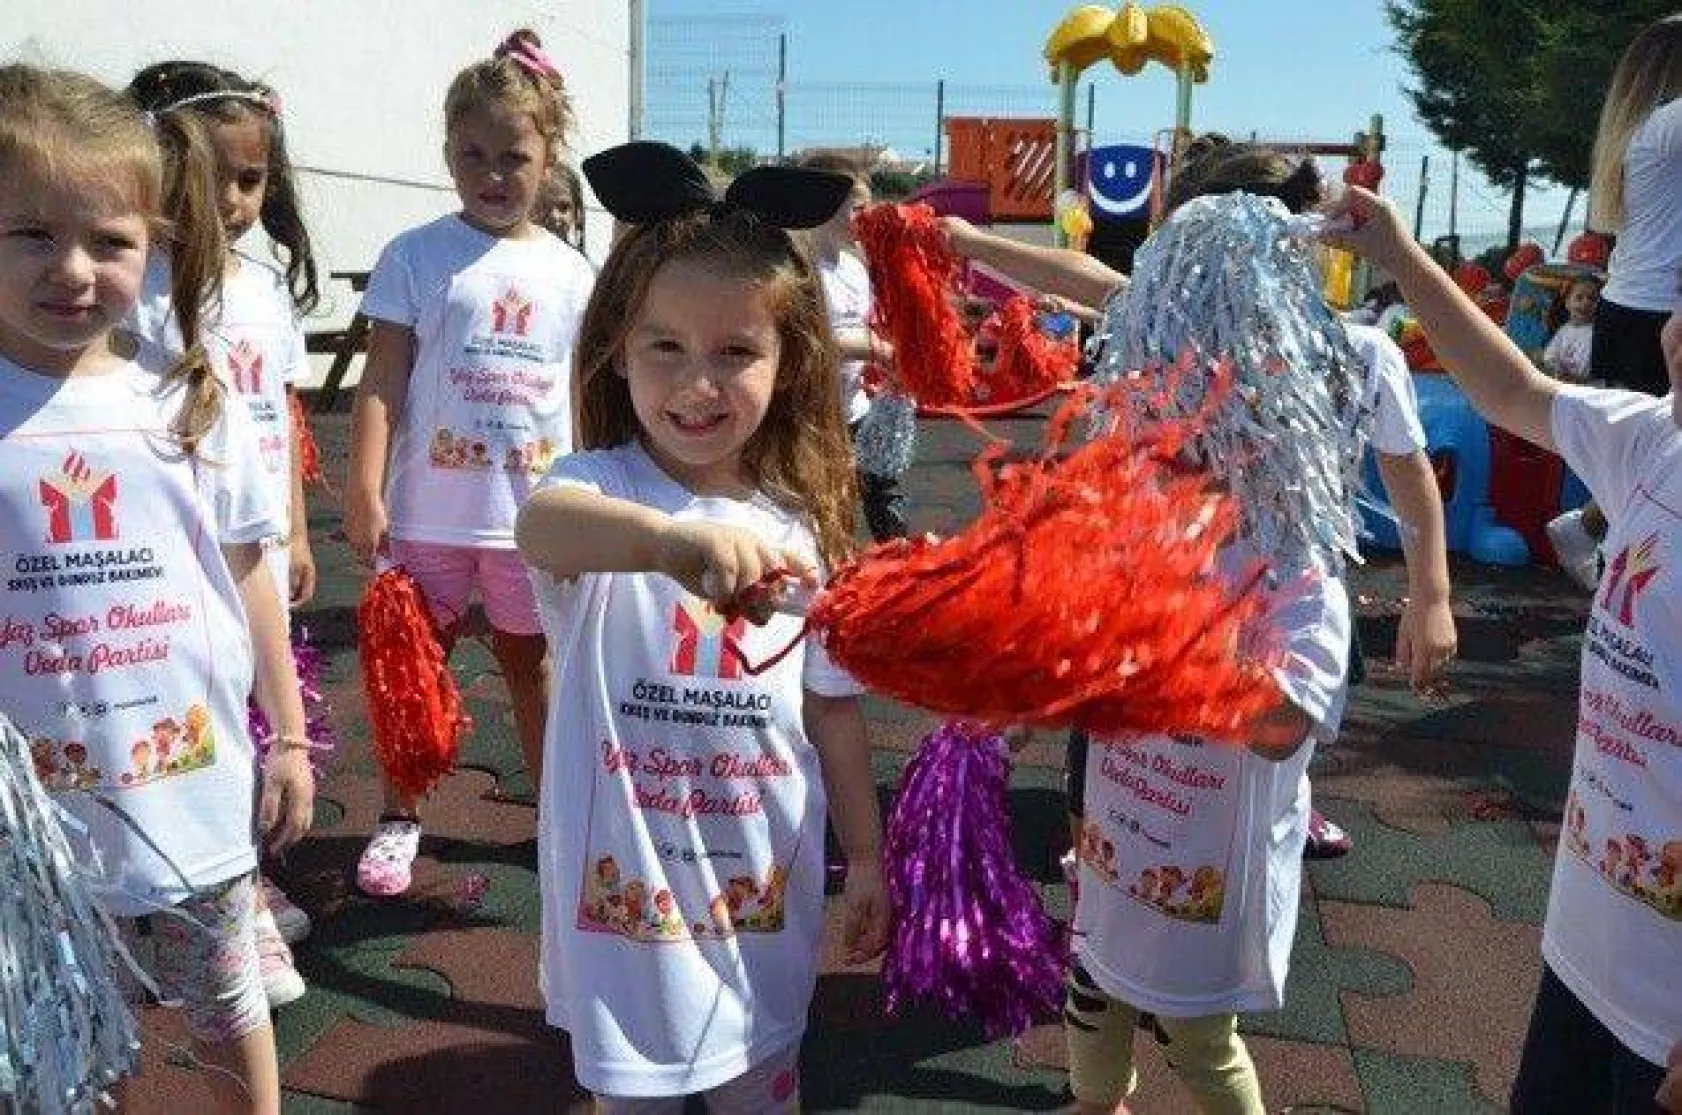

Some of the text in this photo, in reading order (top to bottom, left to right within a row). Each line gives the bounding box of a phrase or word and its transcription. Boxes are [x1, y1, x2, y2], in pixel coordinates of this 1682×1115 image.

[16, 553, 61, 574] ÖZEL
[40, 611, 99, 645] Spor
[87, 636, 170, 674] Partisi
[633, 680, 680, 705] ÖZEL
[643, 748, 703, 781] Spor
